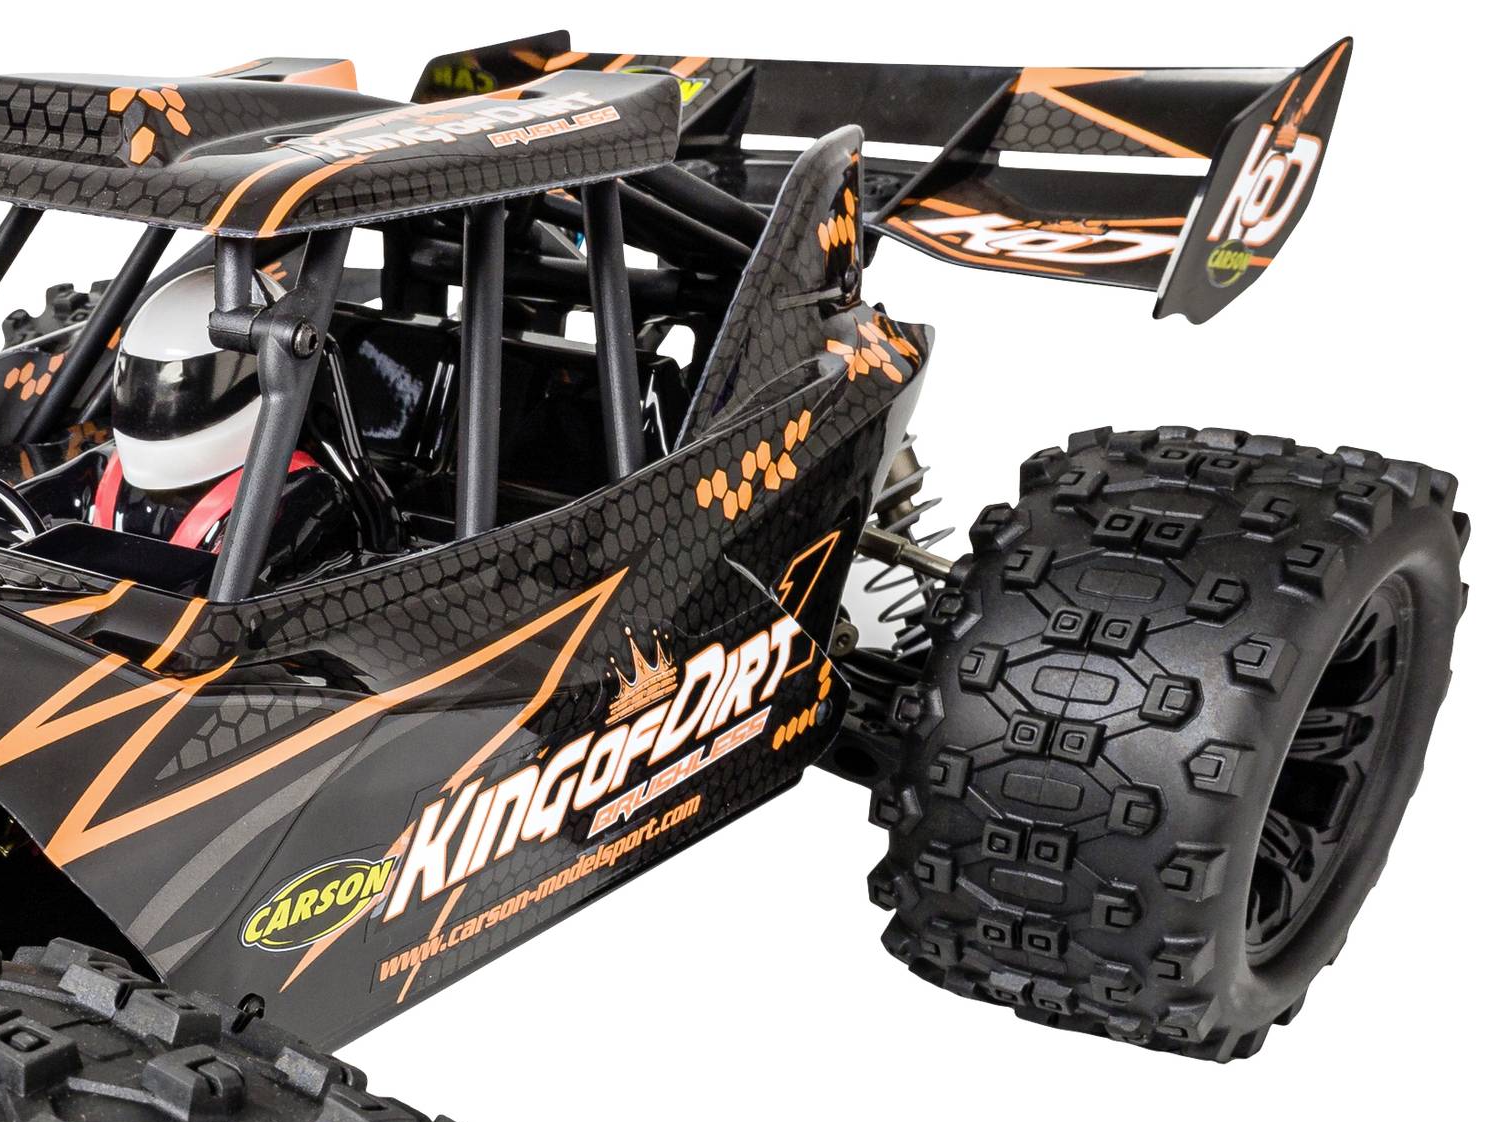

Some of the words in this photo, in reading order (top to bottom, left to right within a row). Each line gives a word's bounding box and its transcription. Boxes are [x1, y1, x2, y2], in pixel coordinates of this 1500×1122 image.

[488, 106, 620, 147] BRUSHLESS
[1207, 249, 1251, 271] CARSON
[588, 705, 771, 838] BRUSHLESS
[244, 861, 393, 943] CARSON
[378, 794, 701, 982] www.carson-modelsport.com
